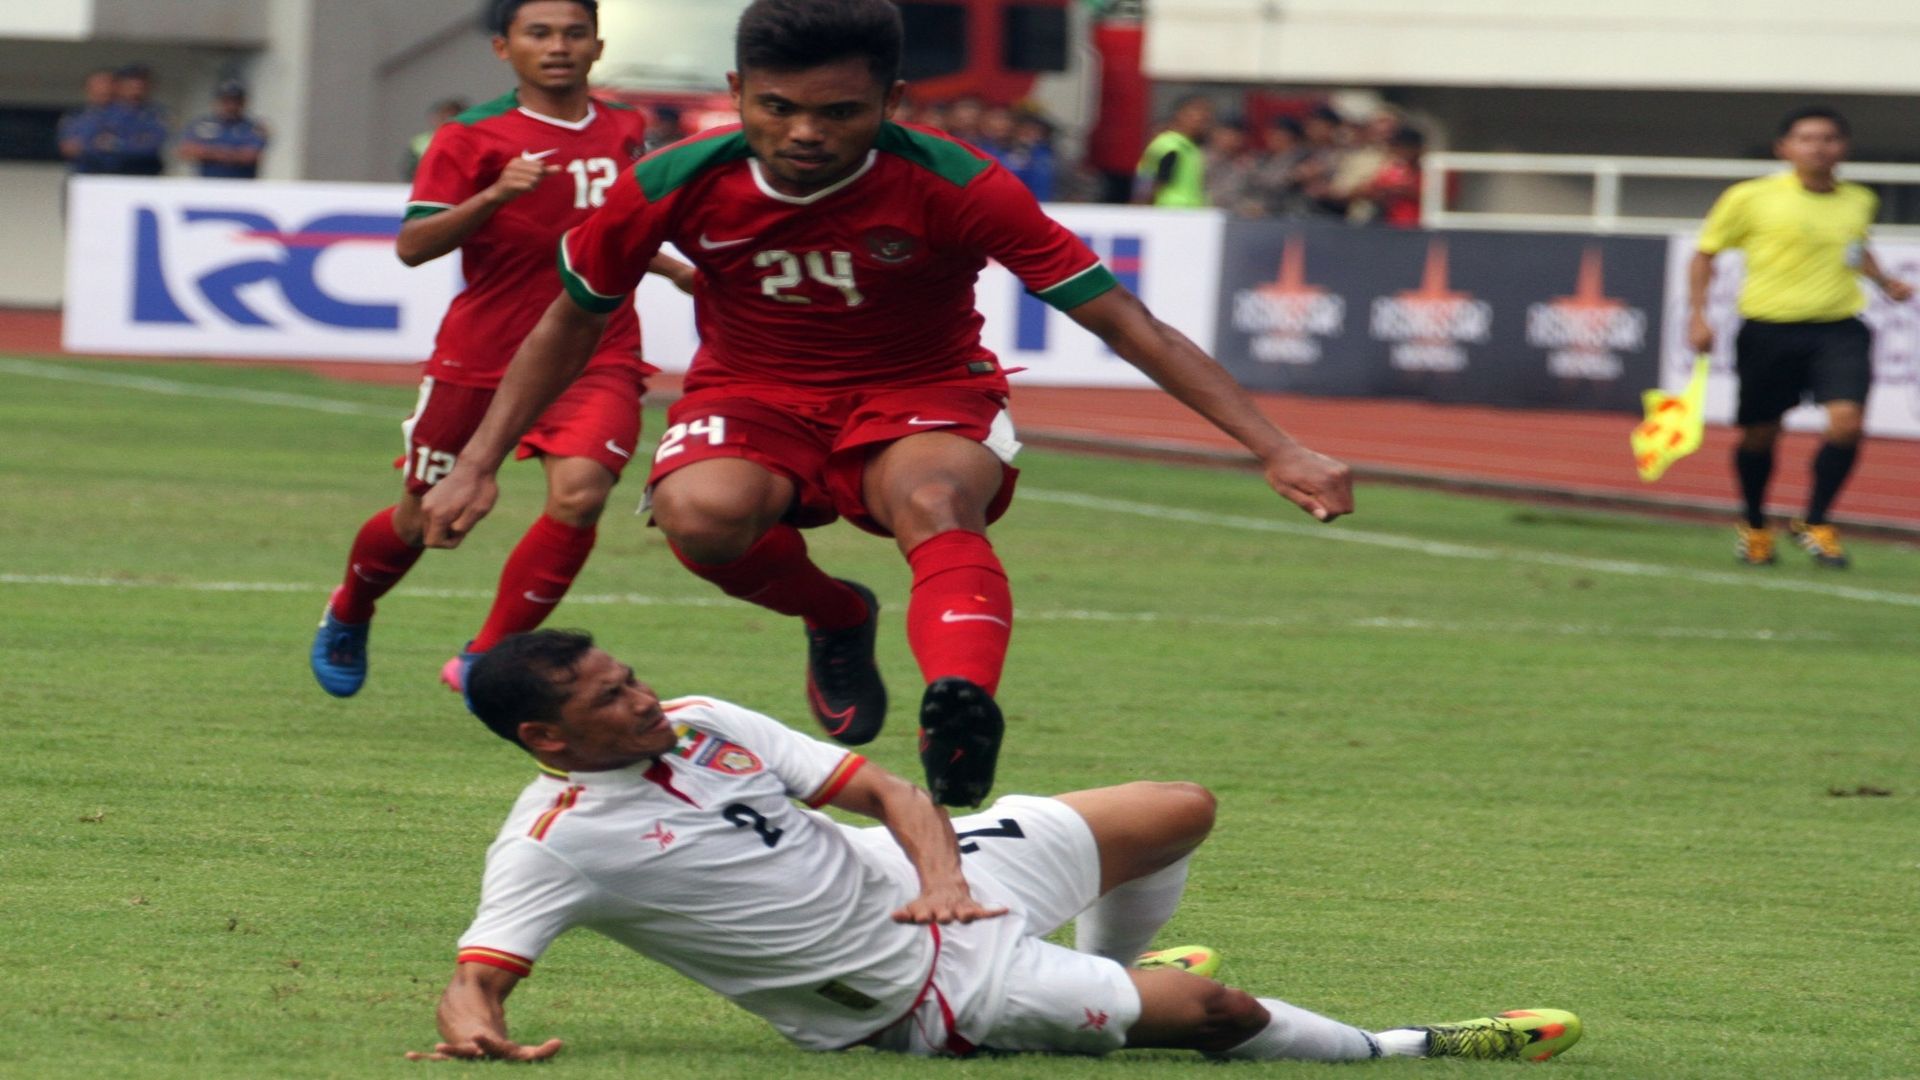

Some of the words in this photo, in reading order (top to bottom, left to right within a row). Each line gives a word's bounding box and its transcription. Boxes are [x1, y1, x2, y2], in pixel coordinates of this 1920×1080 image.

[566, 157, 618, 209] 12
[754, 250, 862, 306] 24
[655, 415, 725, 464] 24
[415, 446, 457, 485] 12
[723, 803, 784, 848] 2
